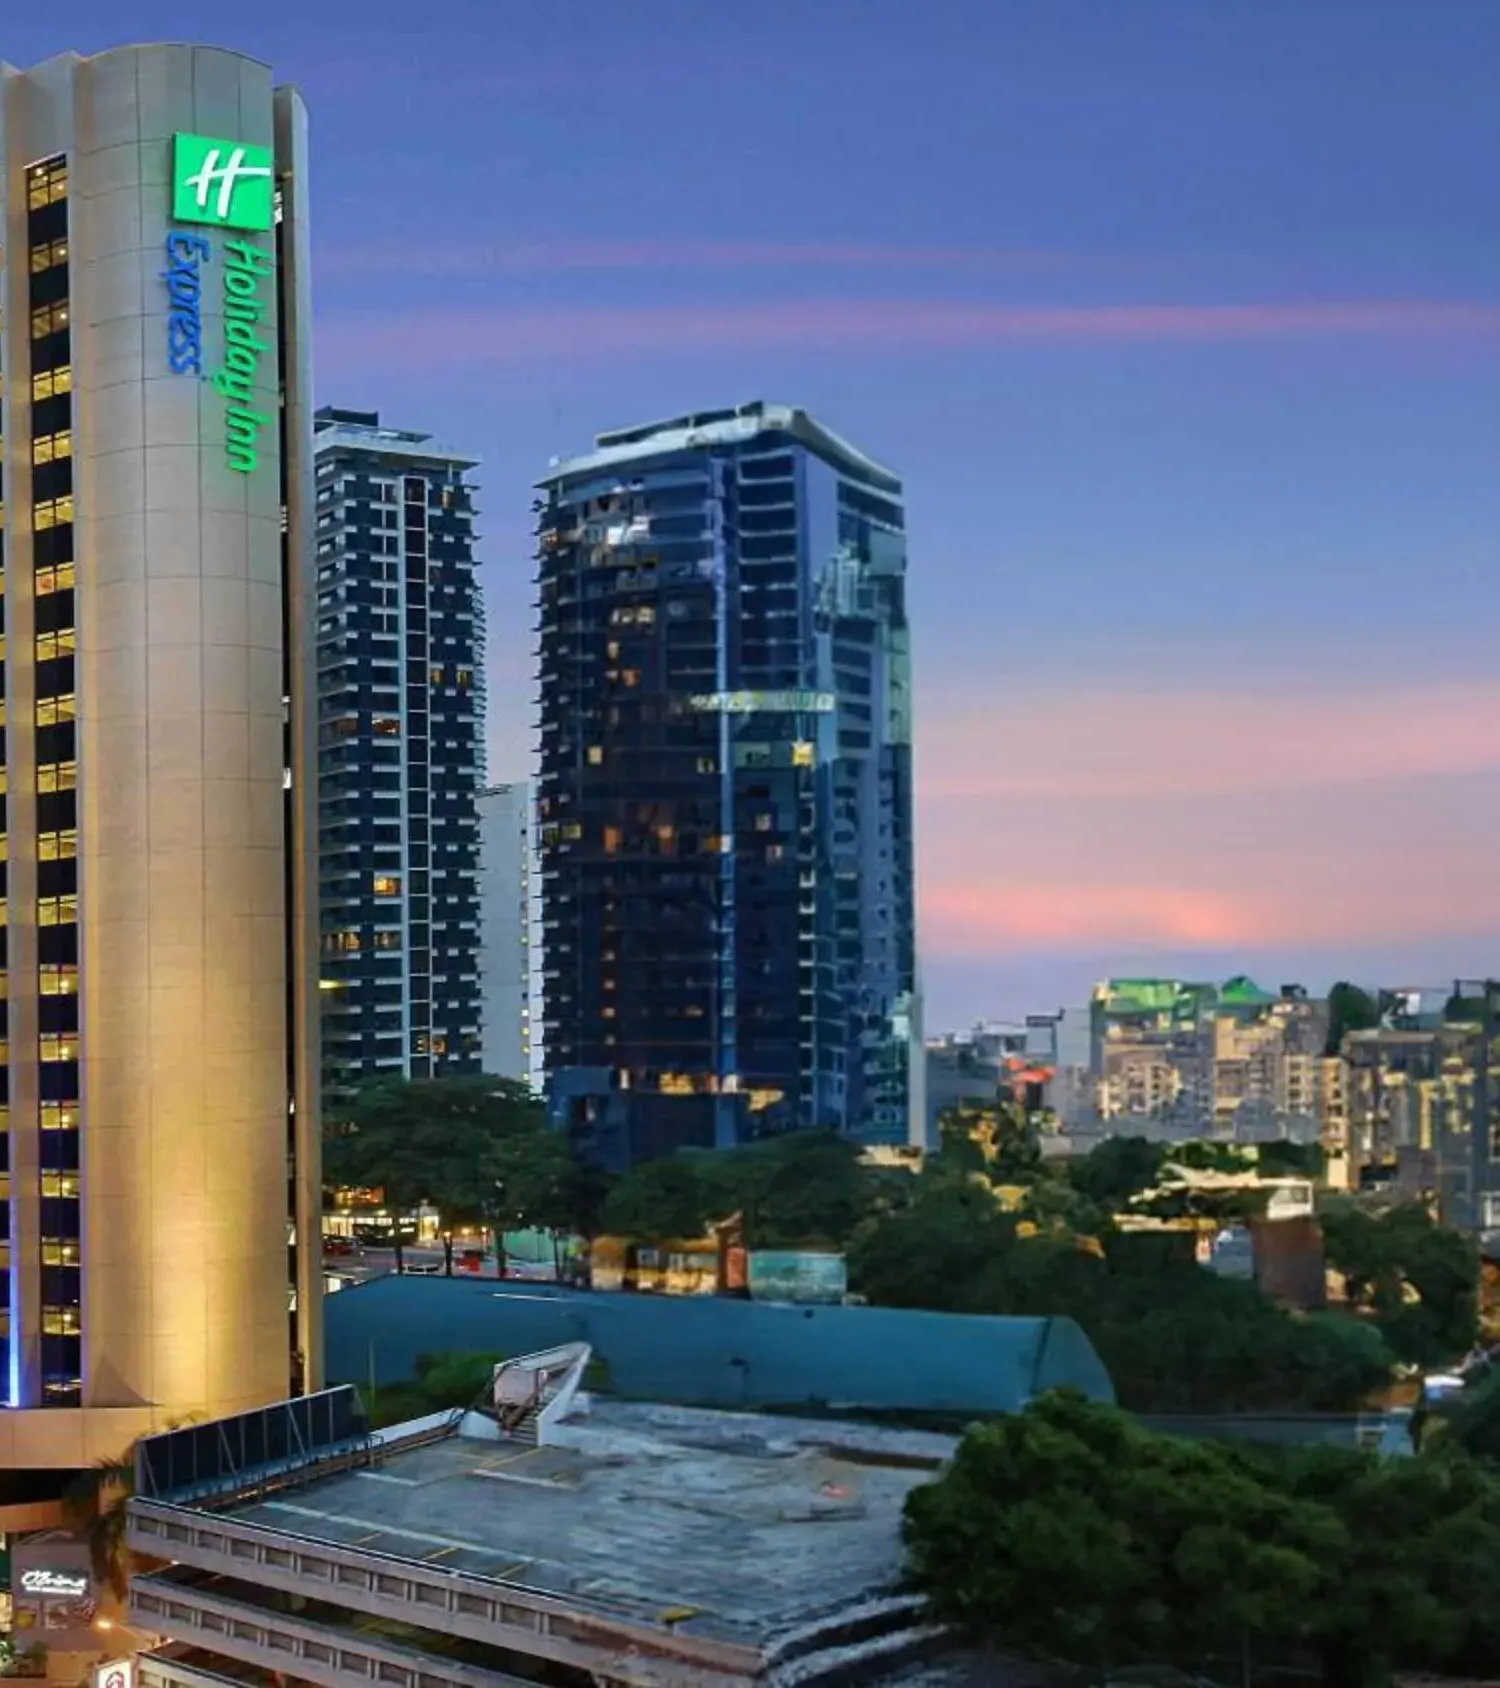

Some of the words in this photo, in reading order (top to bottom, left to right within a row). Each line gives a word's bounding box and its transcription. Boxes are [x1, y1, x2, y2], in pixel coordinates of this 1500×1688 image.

[160, 231, 210, 376] Express
[212, 239, 272, 404] Holiday
[224, 405, 272, 474] Inn
